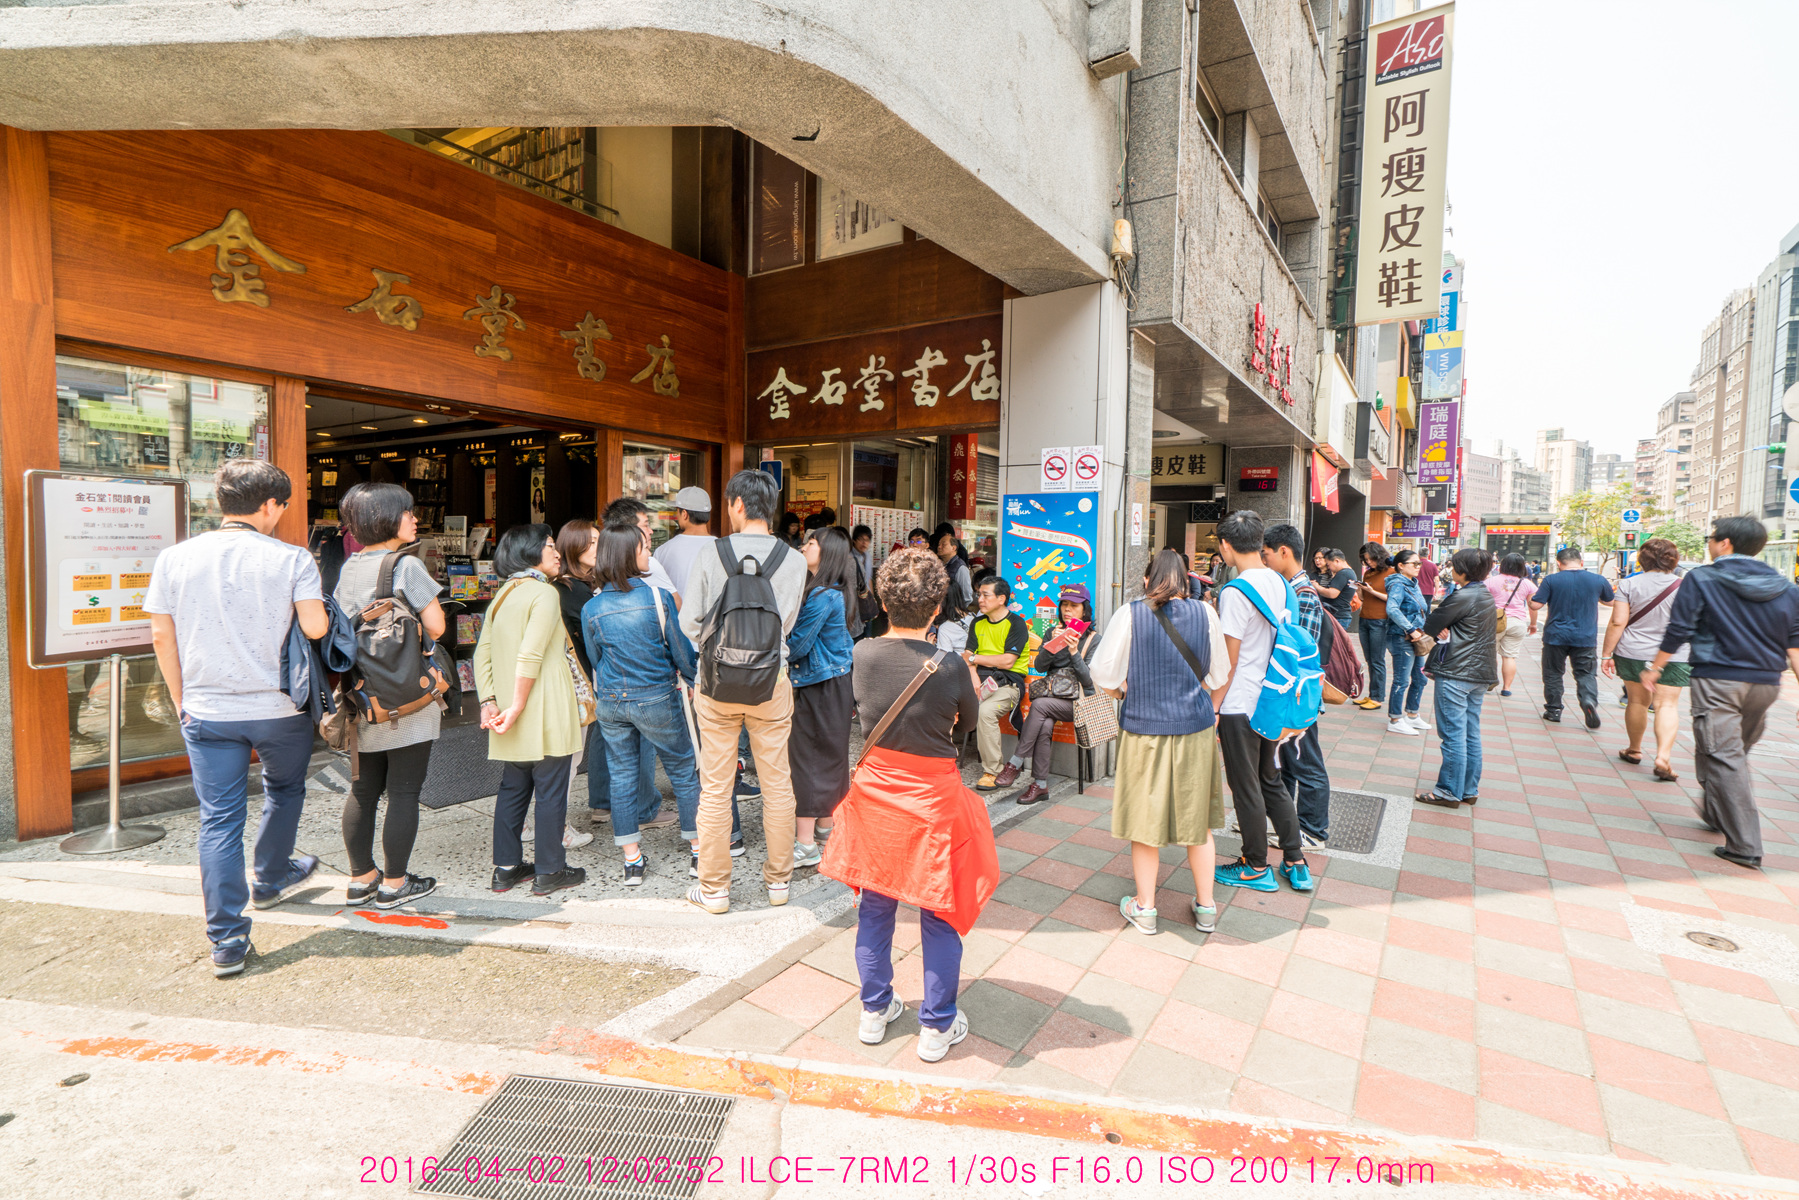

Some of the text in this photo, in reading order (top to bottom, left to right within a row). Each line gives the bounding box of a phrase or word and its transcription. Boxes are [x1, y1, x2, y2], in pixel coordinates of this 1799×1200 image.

[1376, 61, 1441, 82] Amiable Stylish Outlook
[1377, 88, 1430, 308] 阿瘦皮鞋
[168, 208, 681, 399] 金石堂書店
[1439, 352, 1449, 371] VIVI
[756, 339, 1001, 421] 金石堂書店
[1428, 405, 1449, 441] 瑞庭
[1258, 480, 1276, 490] 161
[1403, 517, 1431, 532] 瑞庭
